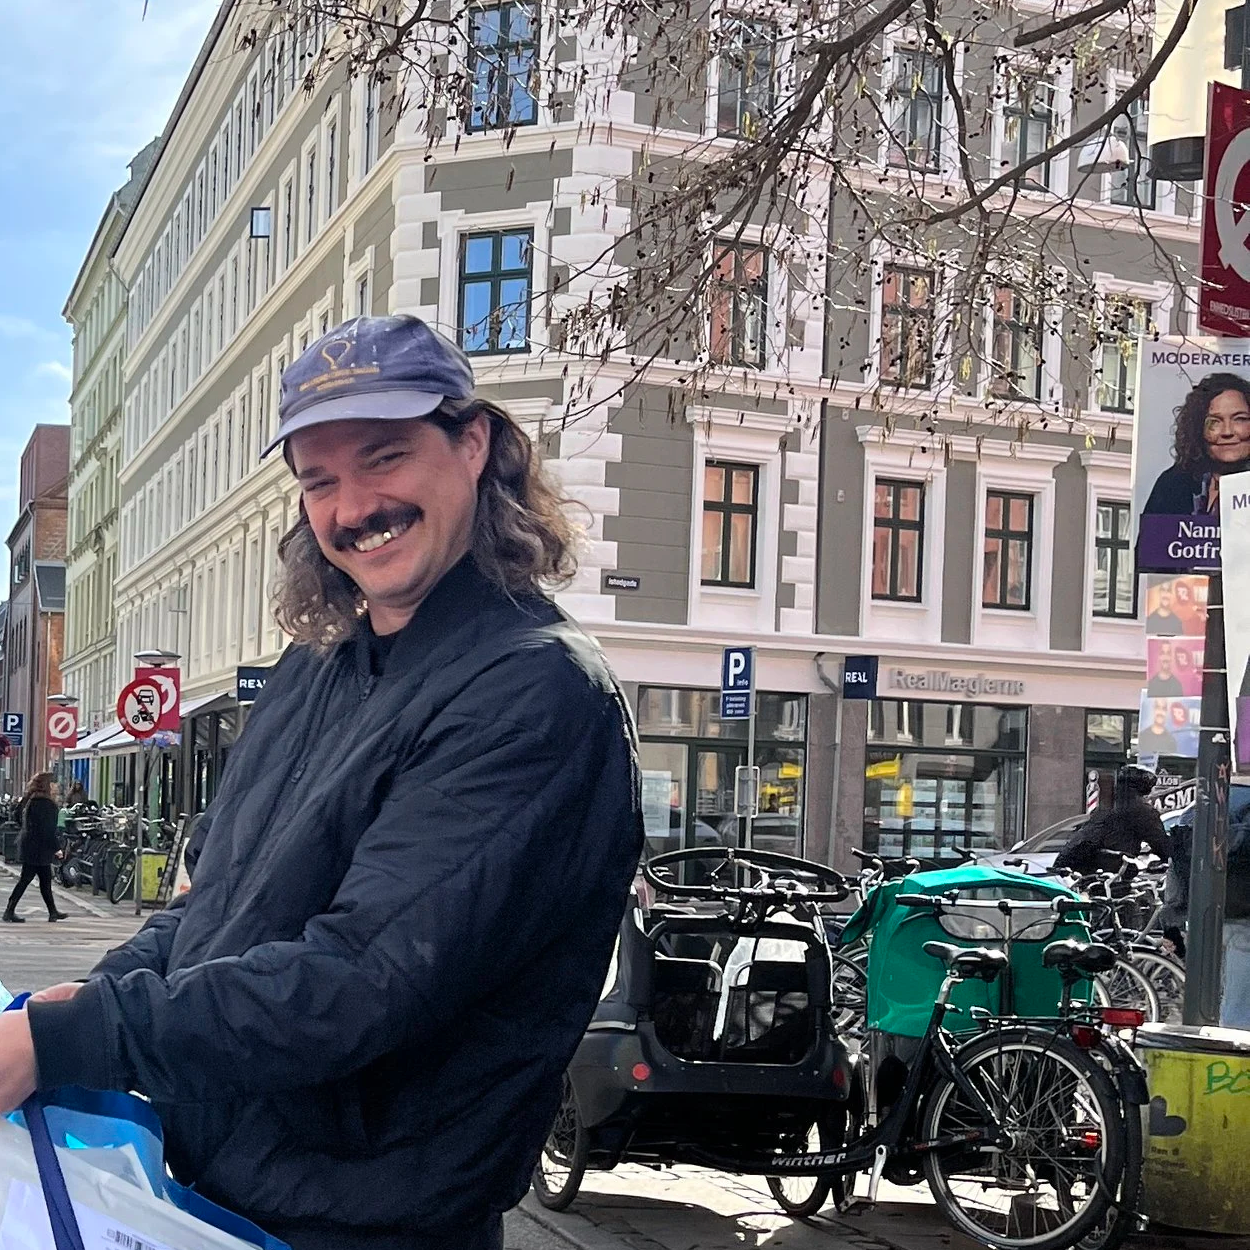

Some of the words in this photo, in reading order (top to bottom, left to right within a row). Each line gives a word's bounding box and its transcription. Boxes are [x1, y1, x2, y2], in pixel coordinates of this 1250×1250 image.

[728, 651, 746, 687] P
[845, 671, 868, 683] REAL
[771, 1152, 847, 1167] winther
